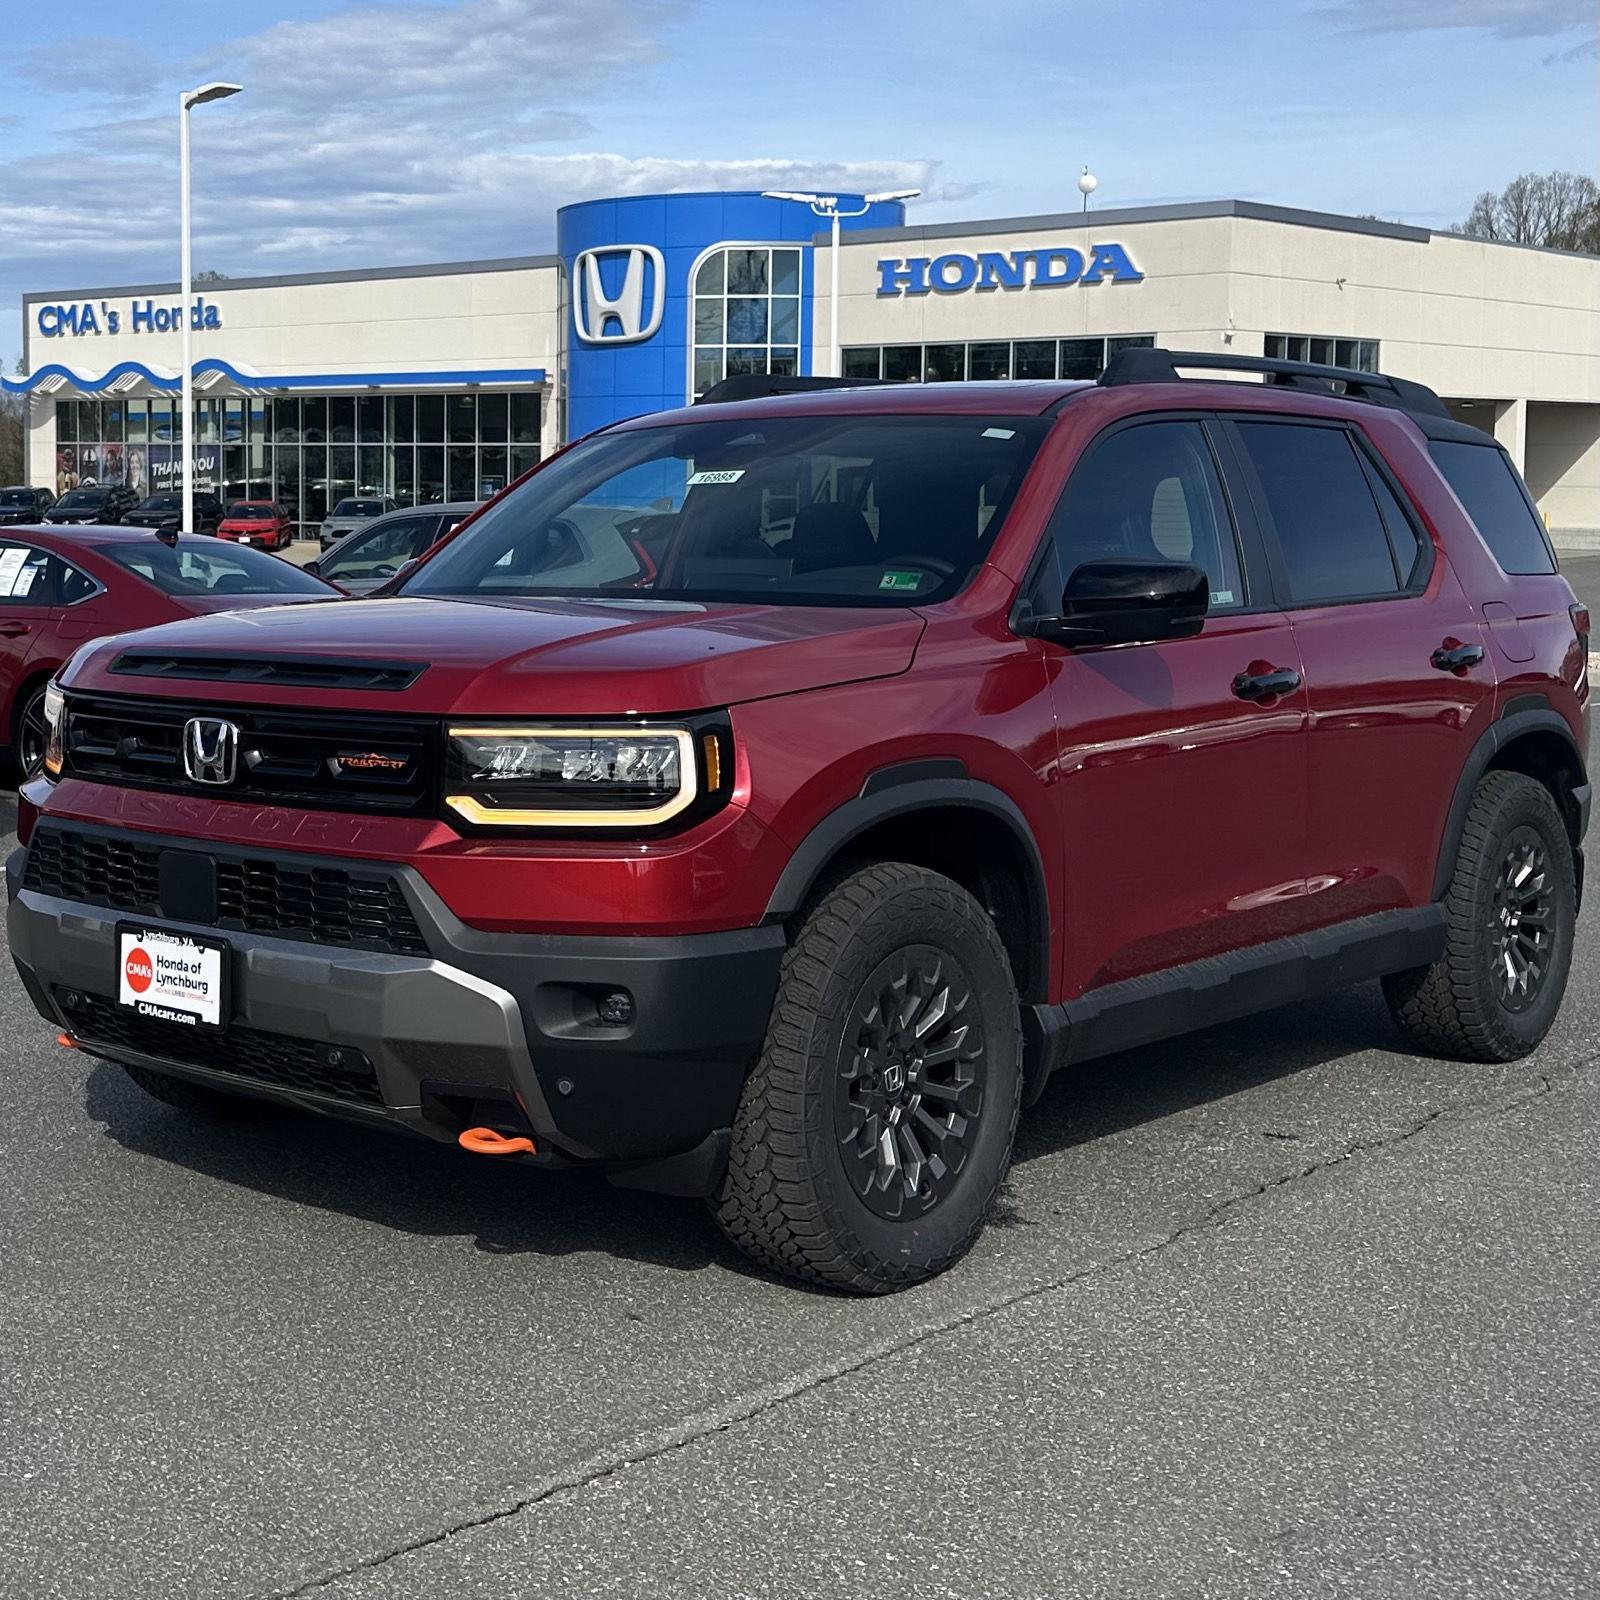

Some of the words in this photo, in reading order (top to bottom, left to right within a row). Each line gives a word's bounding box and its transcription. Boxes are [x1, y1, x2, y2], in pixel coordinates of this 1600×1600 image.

[876, 243, 1144, 298] HONDA
[38, 301, 120, 338] CMA's
[132, 297, 222, 333] Honda
[152, 460, 183, 476] THAN
[191, 456, 214, 471] YOU
[886, 576, 894, 585] 3
[339, 757, 406, 769] TRAILSPORT
[126, 962, 153, 978] CMA's
[156, 955, 189, 972] Honda
[190, 963, 202, 975] of
[156, 970, 209, 995] Lynchburg
[138, 1002, 196, 1026] CMAcars.com
